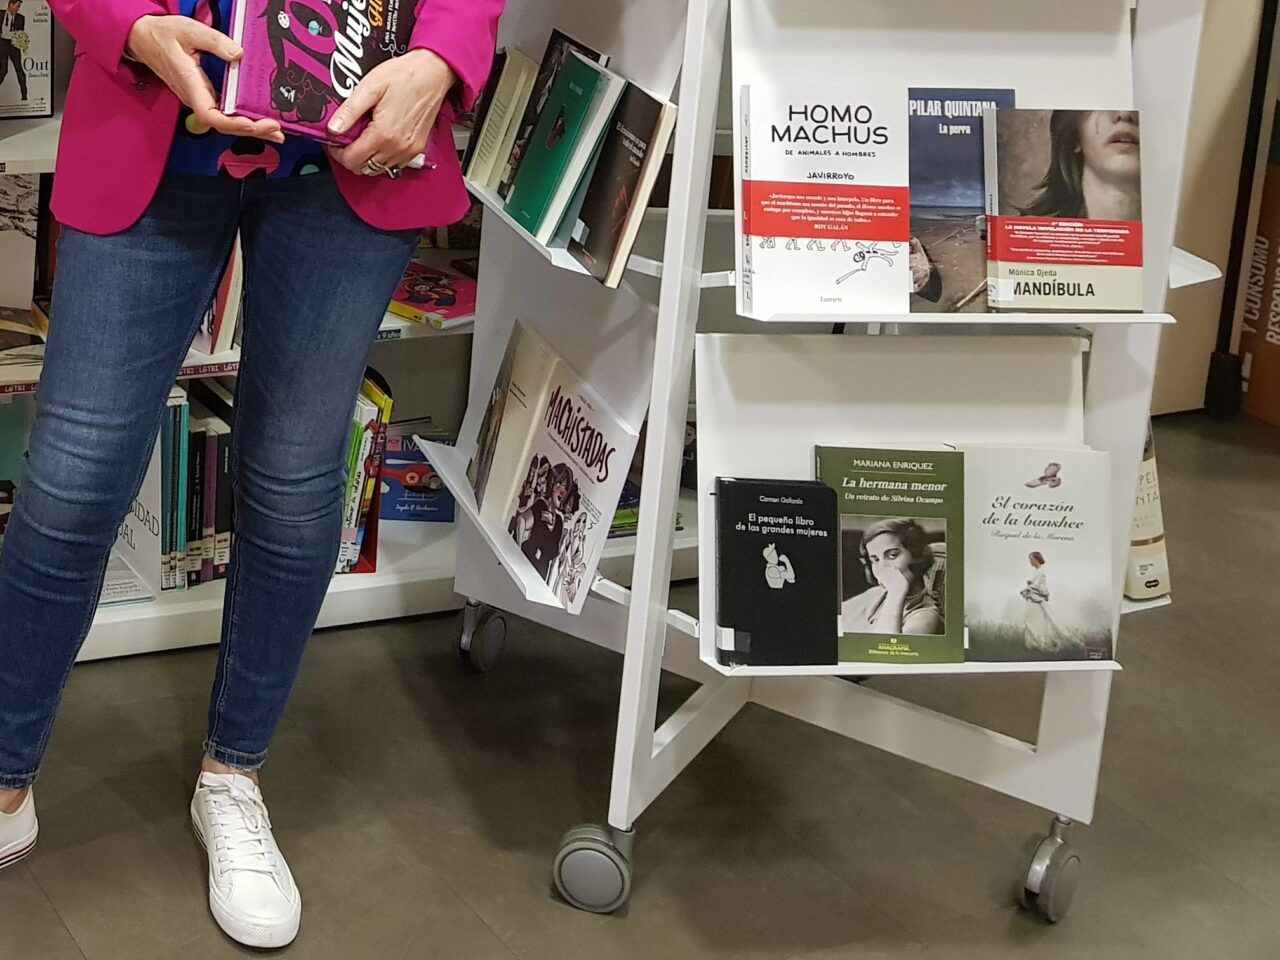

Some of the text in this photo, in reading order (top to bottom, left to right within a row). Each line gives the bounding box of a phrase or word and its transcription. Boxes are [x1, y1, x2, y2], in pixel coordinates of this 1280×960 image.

[789, 105, 872, 124] HOMO
[910, 101, 941, 115] PILAR
[771, 125, 888, 145] MACHUS
[807, 172, 854, 180] JAVIRROYO
[1037, 269, 1057, 277] Ojeda
[1014, 279, 1095, 296] MANDÍBULA
[854, 459, 933, 470] MARIANA ENRIQUEZ
[842, 478, 946, 491] La hermana menor
[992, 496, 1074, 512] El corazón
[759, 515, 793, 526] pequeño
[796, 516, 814, 525] libro
[983, 512, 1084, 530] de la banshee
[736, 522, 827, 537] de las grandes mujeres
